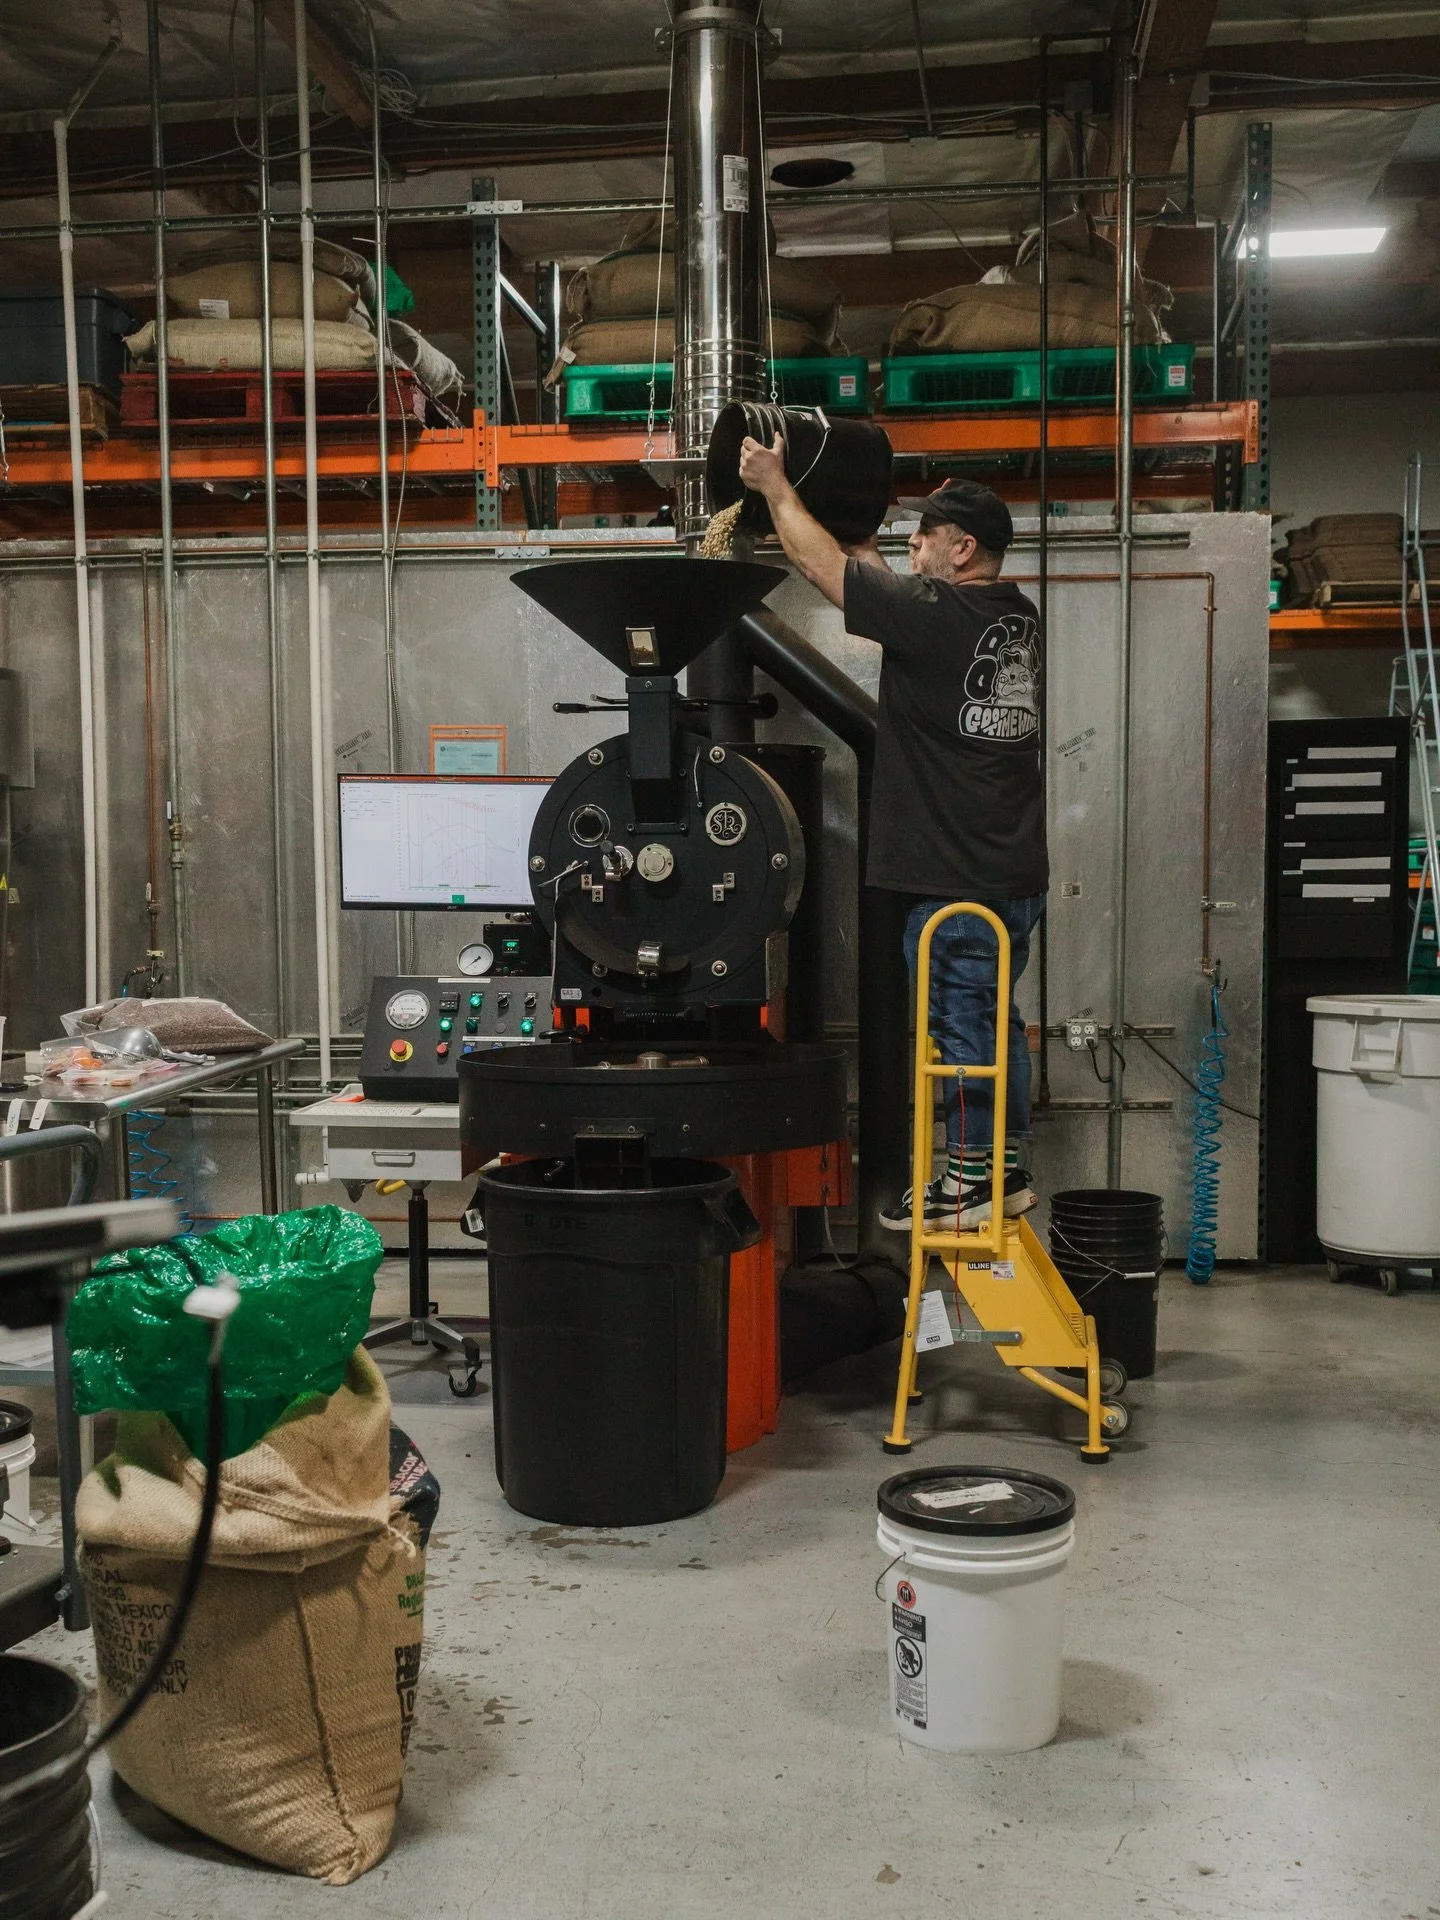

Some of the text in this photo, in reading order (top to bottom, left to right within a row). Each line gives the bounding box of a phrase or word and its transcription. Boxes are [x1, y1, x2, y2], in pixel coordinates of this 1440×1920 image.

[965, 705, 1009, 733] GOOD
[983, 708, 1018, 737] TIME
[968, 1262, 990, 1270] ULINE
